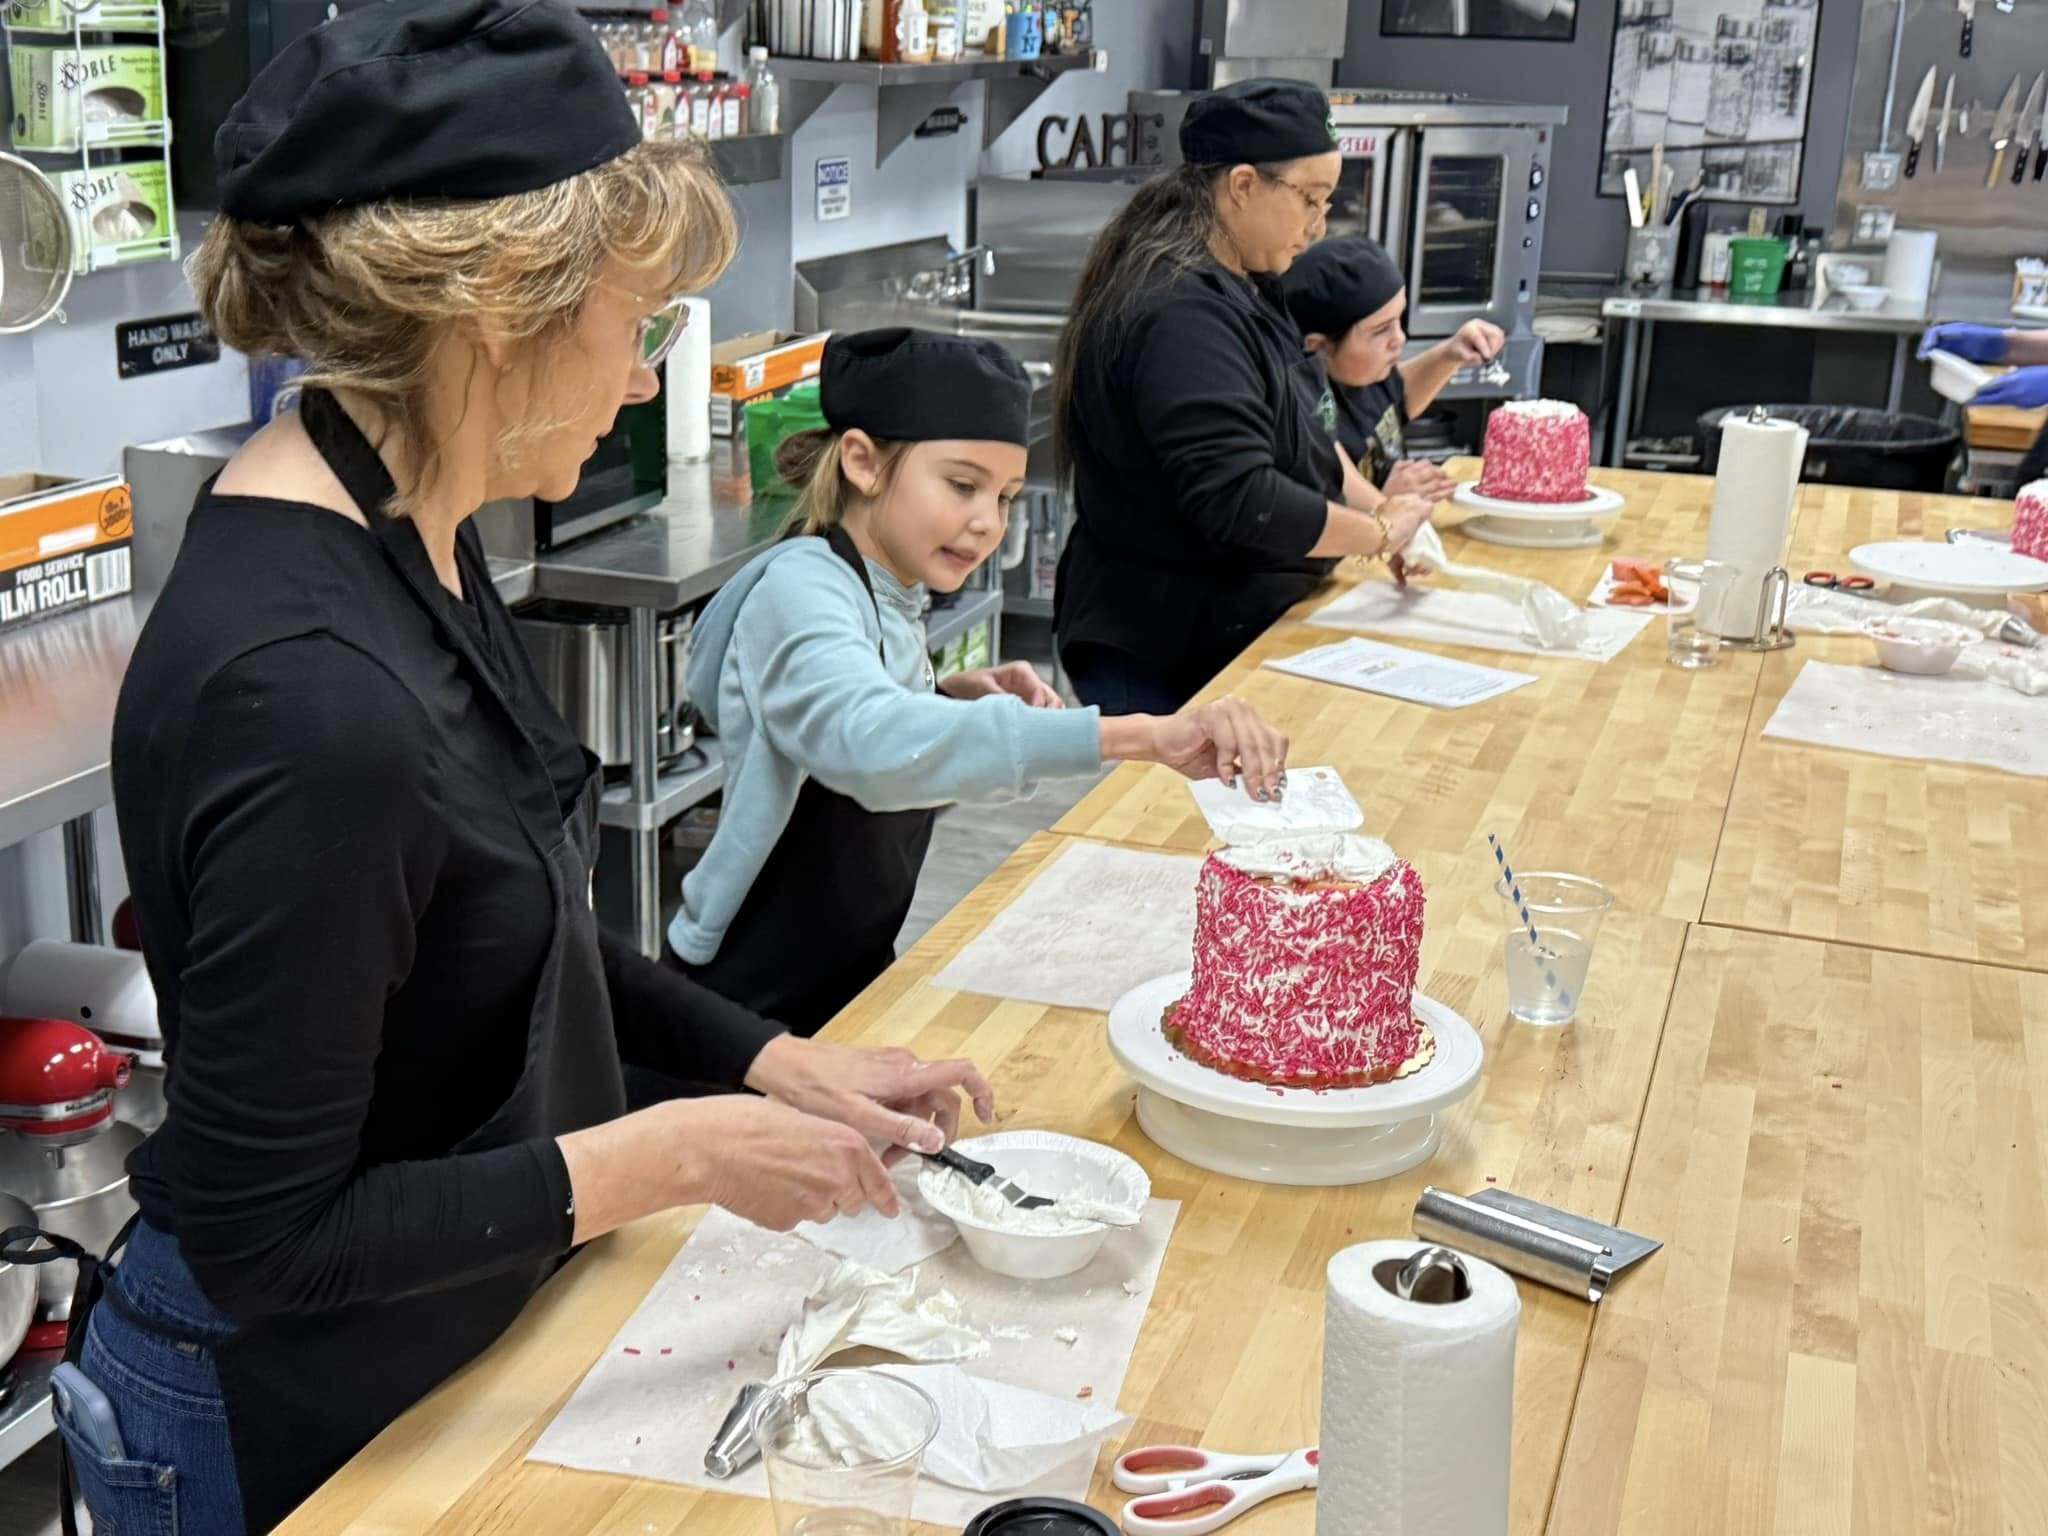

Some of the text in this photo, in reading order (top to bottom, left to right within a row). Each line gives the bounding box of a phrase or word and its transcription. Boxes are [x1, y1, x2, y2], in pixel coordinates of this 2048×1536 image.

[1037, 112, 1164, 169] CAFE
[71, 171, 119, 210] NOBL
[128, 320, 209, 348] HAND WASH
[152, 342, 189, 365] ONLY
[16, 552, 85, 586] FOOD SERVICE
[0, 570, 87, 621] ILM ROLL
